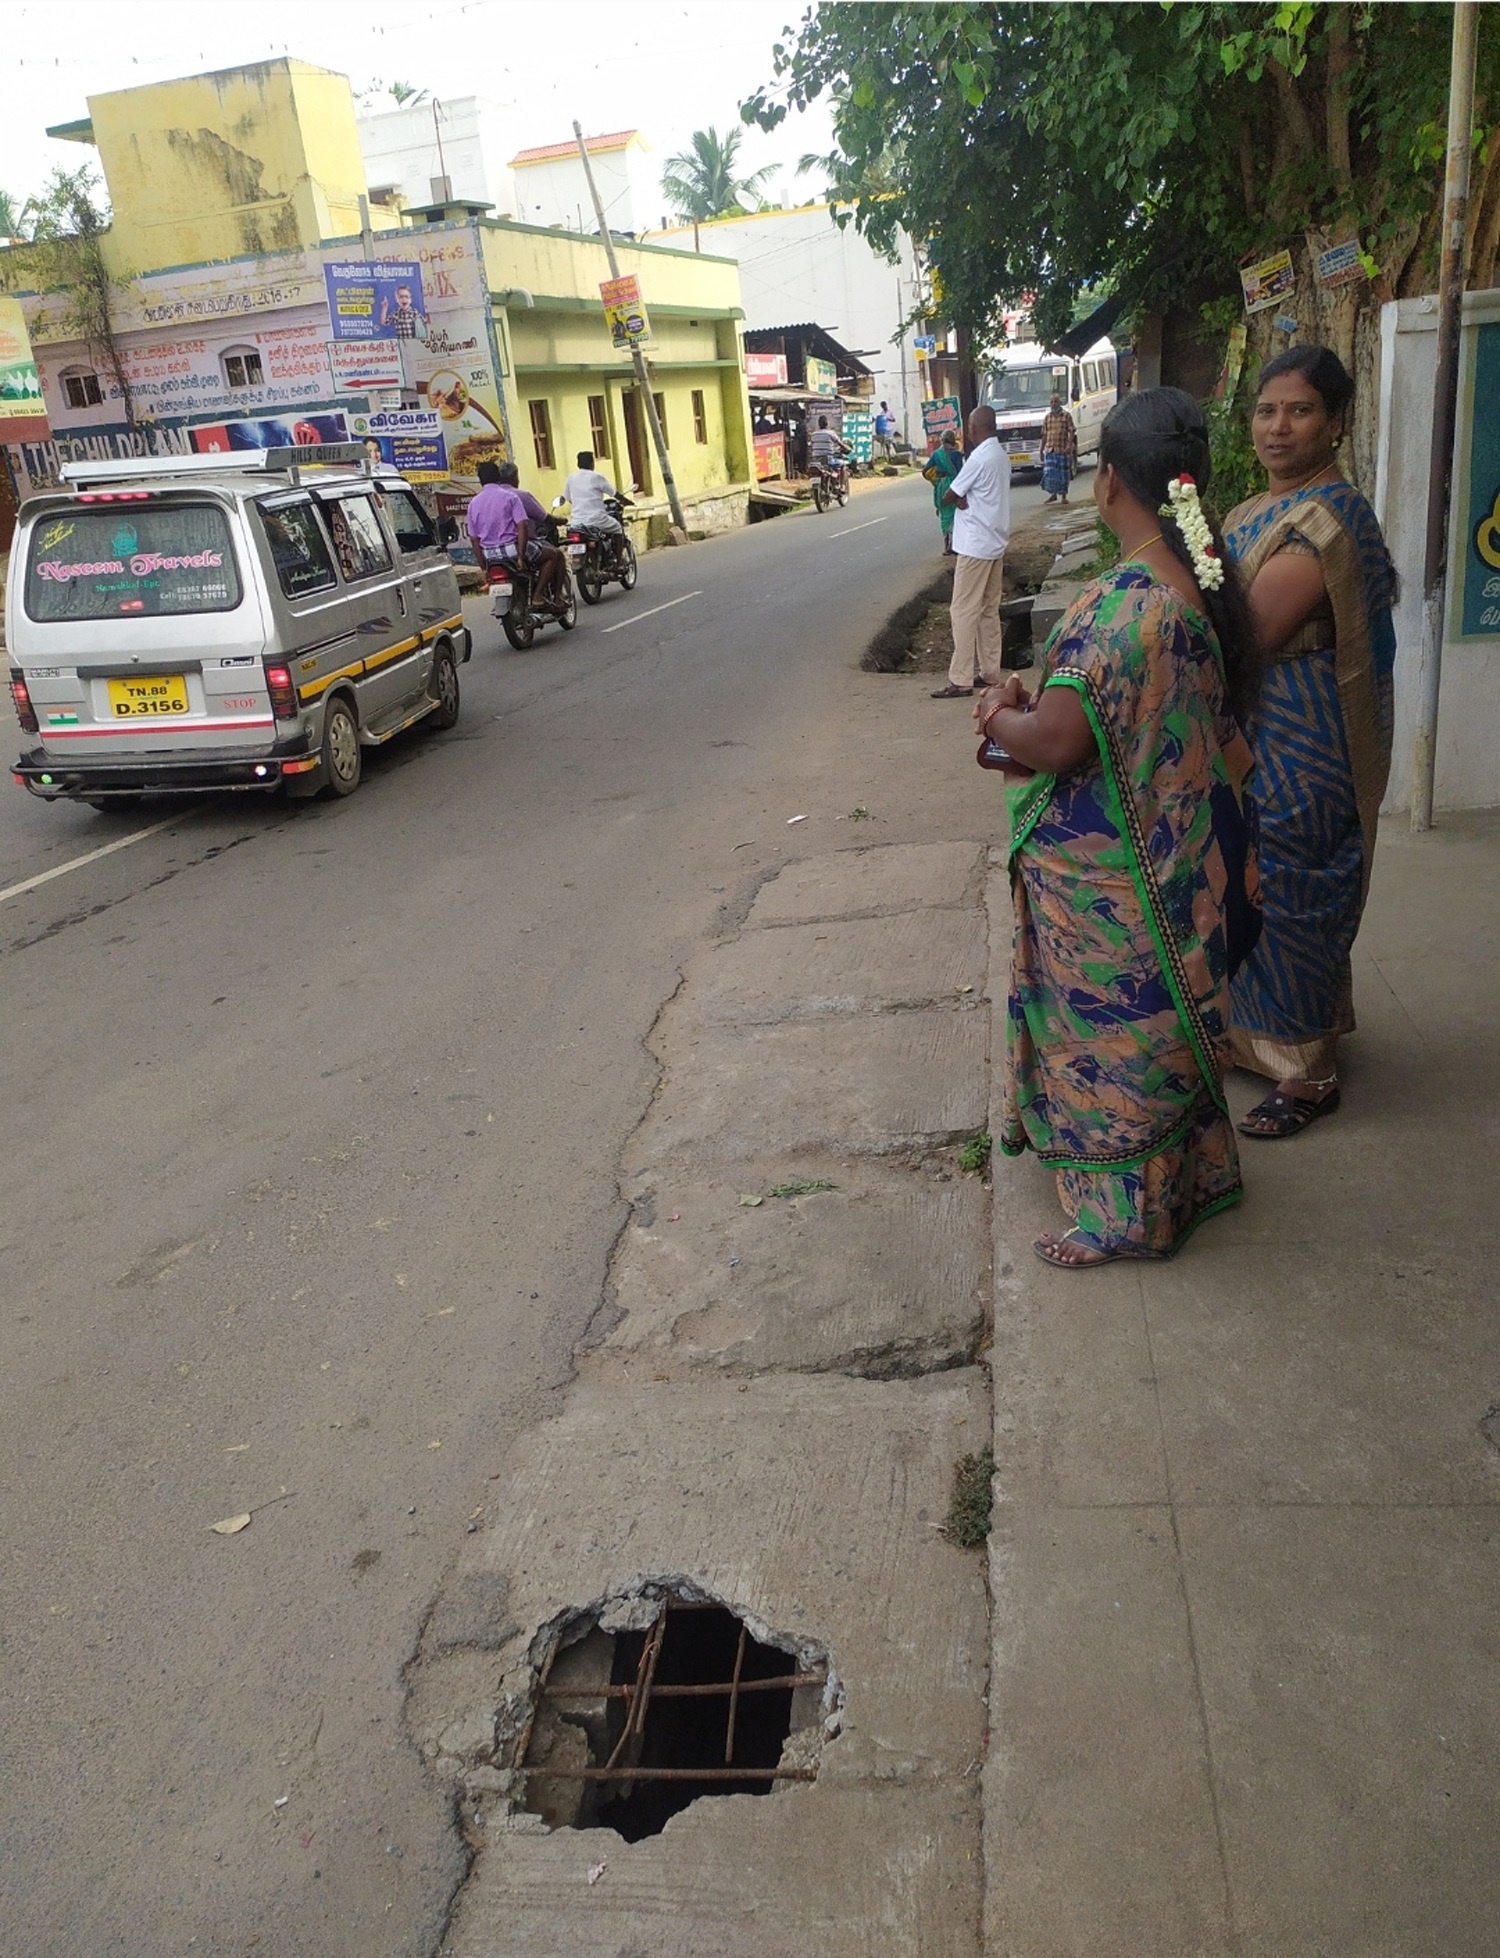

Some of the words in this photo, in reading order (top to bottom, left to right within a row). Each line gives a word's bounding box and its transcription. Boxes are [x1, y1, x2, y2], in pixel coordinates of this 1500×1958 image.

[369, 411, 437, 427] விவேகா
[26, 440, 67, 477] THE
[291, 448, 312, 464] HILLS
[316, 447, 341, 460] QUEEN
[36, 560, 125, 582] Naseem
[130, 549, 223, 576] Travels
[222, 658, 253, 667] Omni
[127, 686, 168, 697] TN.88
[116, 699, 184, 715] D.3156
[223, 698, 257, 710] STOP
